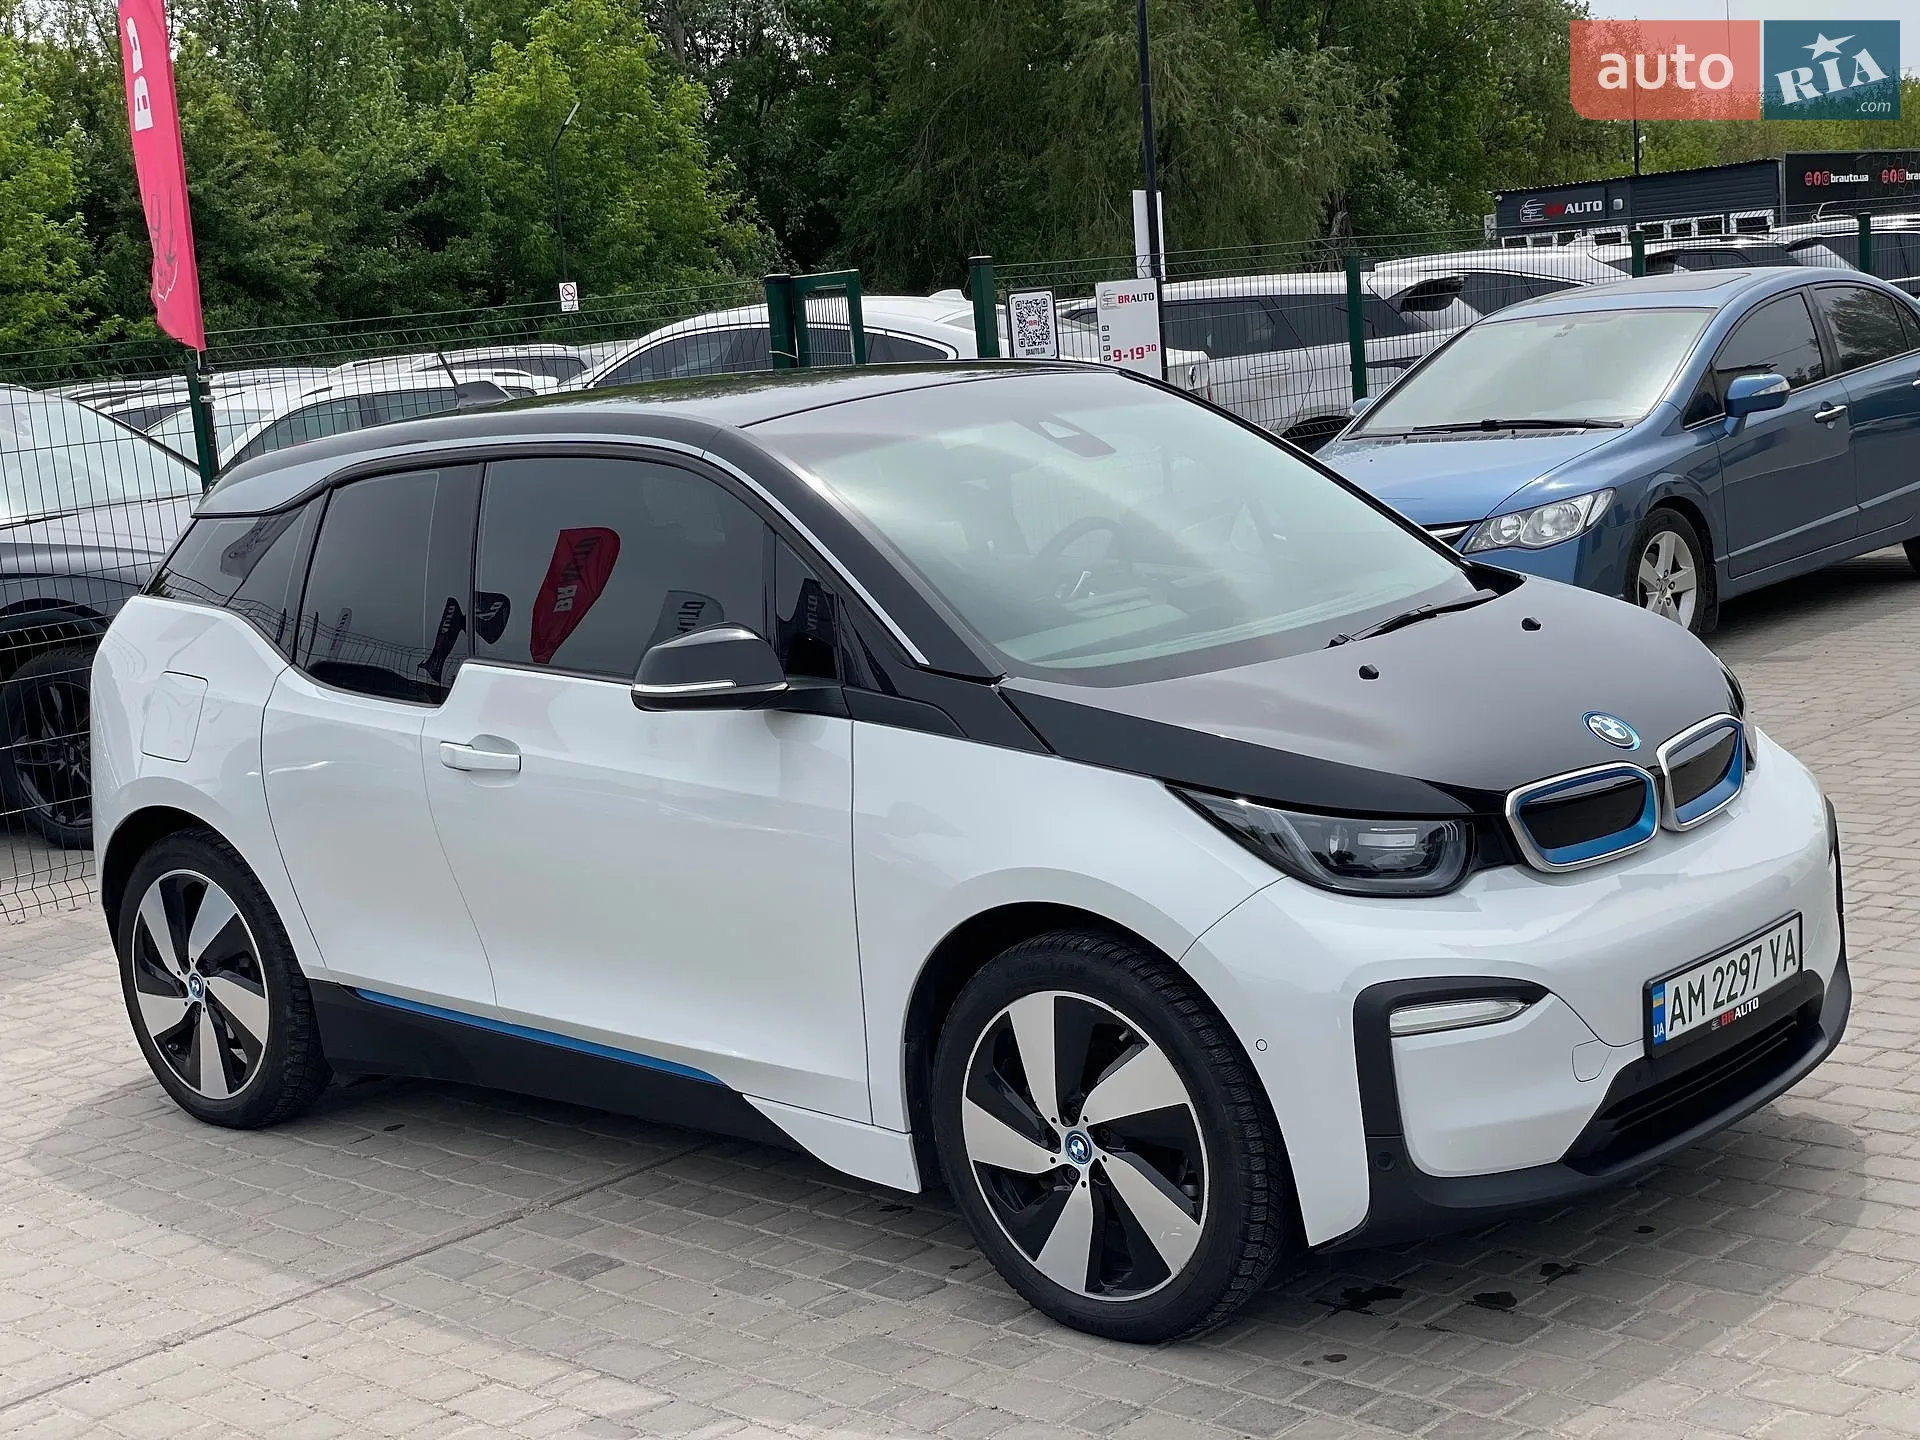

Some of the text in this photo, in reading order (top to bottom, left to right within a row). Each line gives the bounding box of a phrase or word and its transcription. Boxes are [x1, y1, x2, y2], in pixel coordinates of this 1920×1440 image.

[1830, 173, 1869, 183] brauto.ua
[1117, 292, 1155, 304] BRAUTO
[1669, 928, 1796, 1032] AM 2297 YA
[1720, 996, 1760, 1027] BRAUTO
[1653, 1022, 1665, 1038] UA
